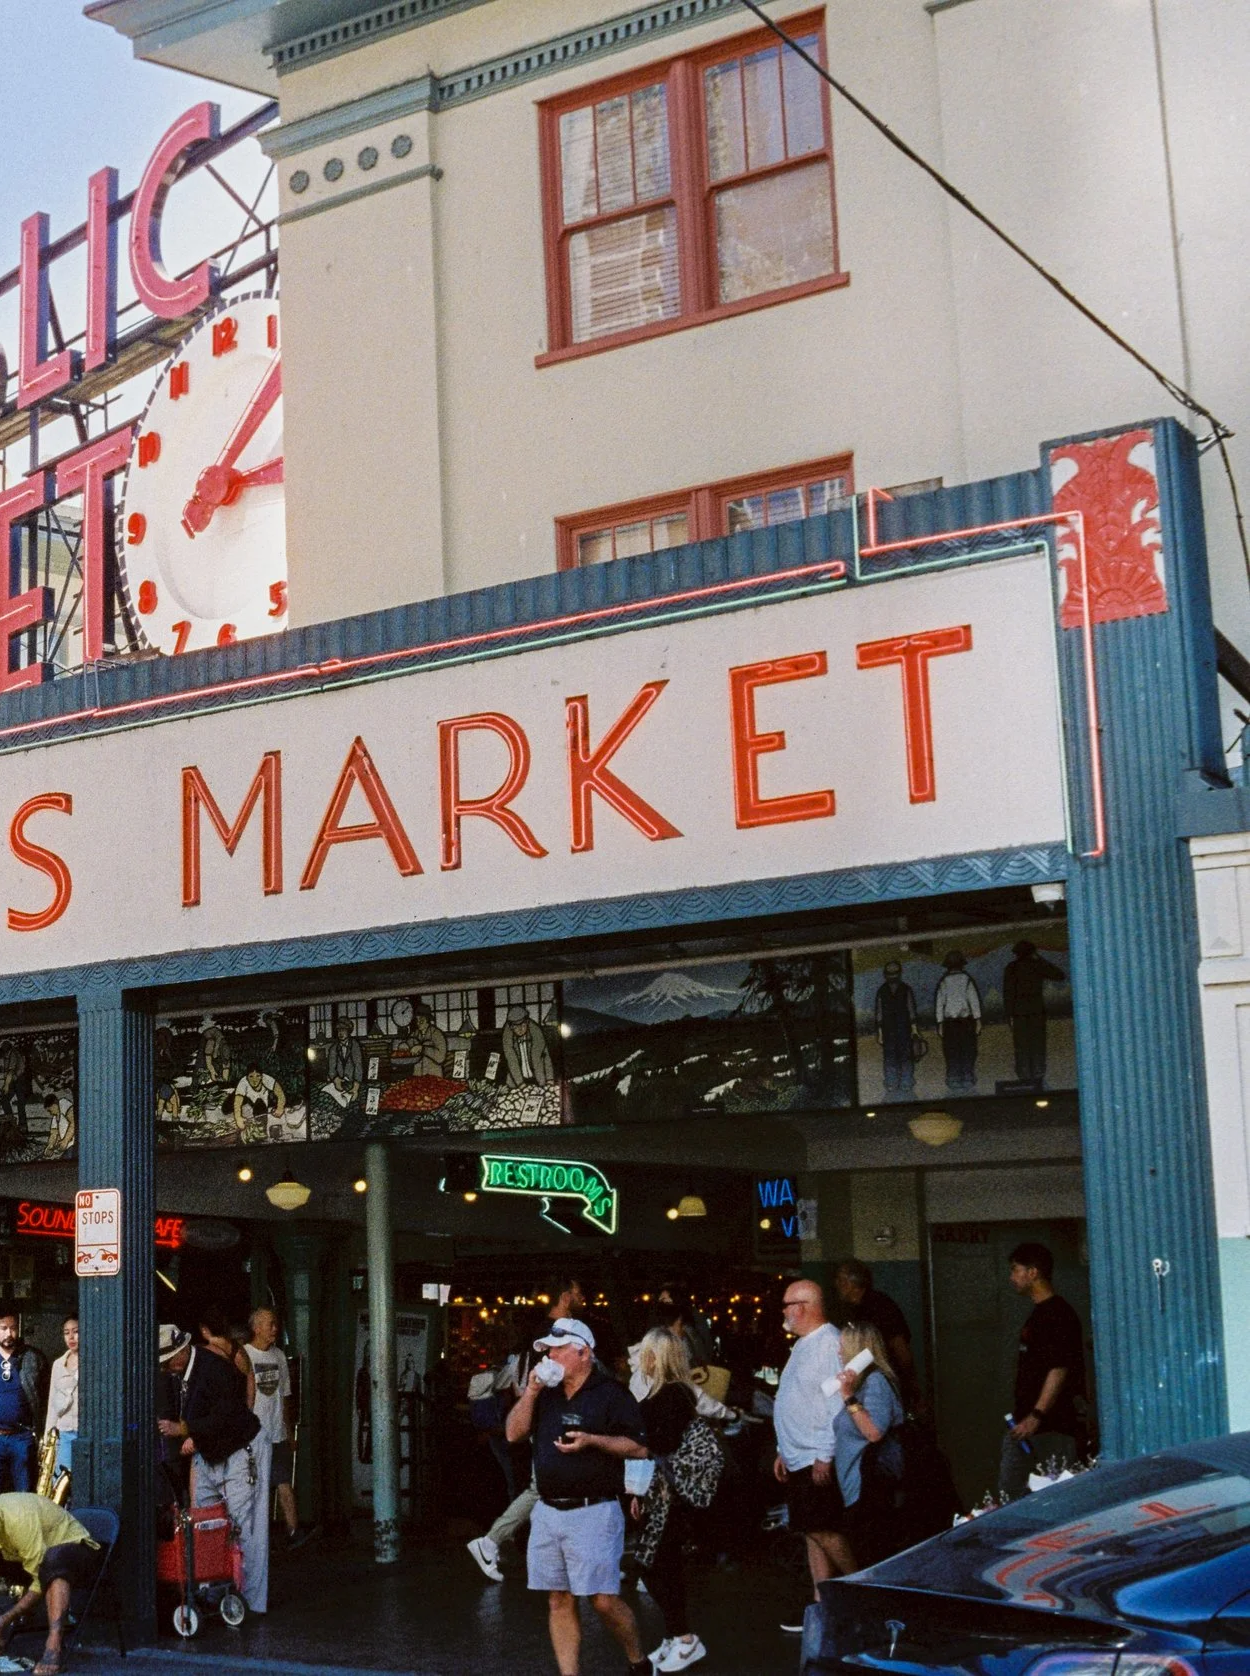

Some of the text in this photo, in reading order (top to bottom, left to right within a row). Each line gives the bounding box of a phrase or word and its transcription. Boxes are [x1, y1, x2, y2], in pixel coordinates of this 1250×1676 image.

[127, 512, 146, 545] 9
[138, 580, 158, 614] 8
[269, 580, 287, 616] 5
[172, 620, 191, 654] 7
[181, 625, 973, 908] MARKET
[78, 1194, 91, 1207] NO
[490, 1161, 611, 1216] RESTROOMS
[82, 1211, 114, 1225] STOPS
[155, 1218, 183, 1238] AFE
